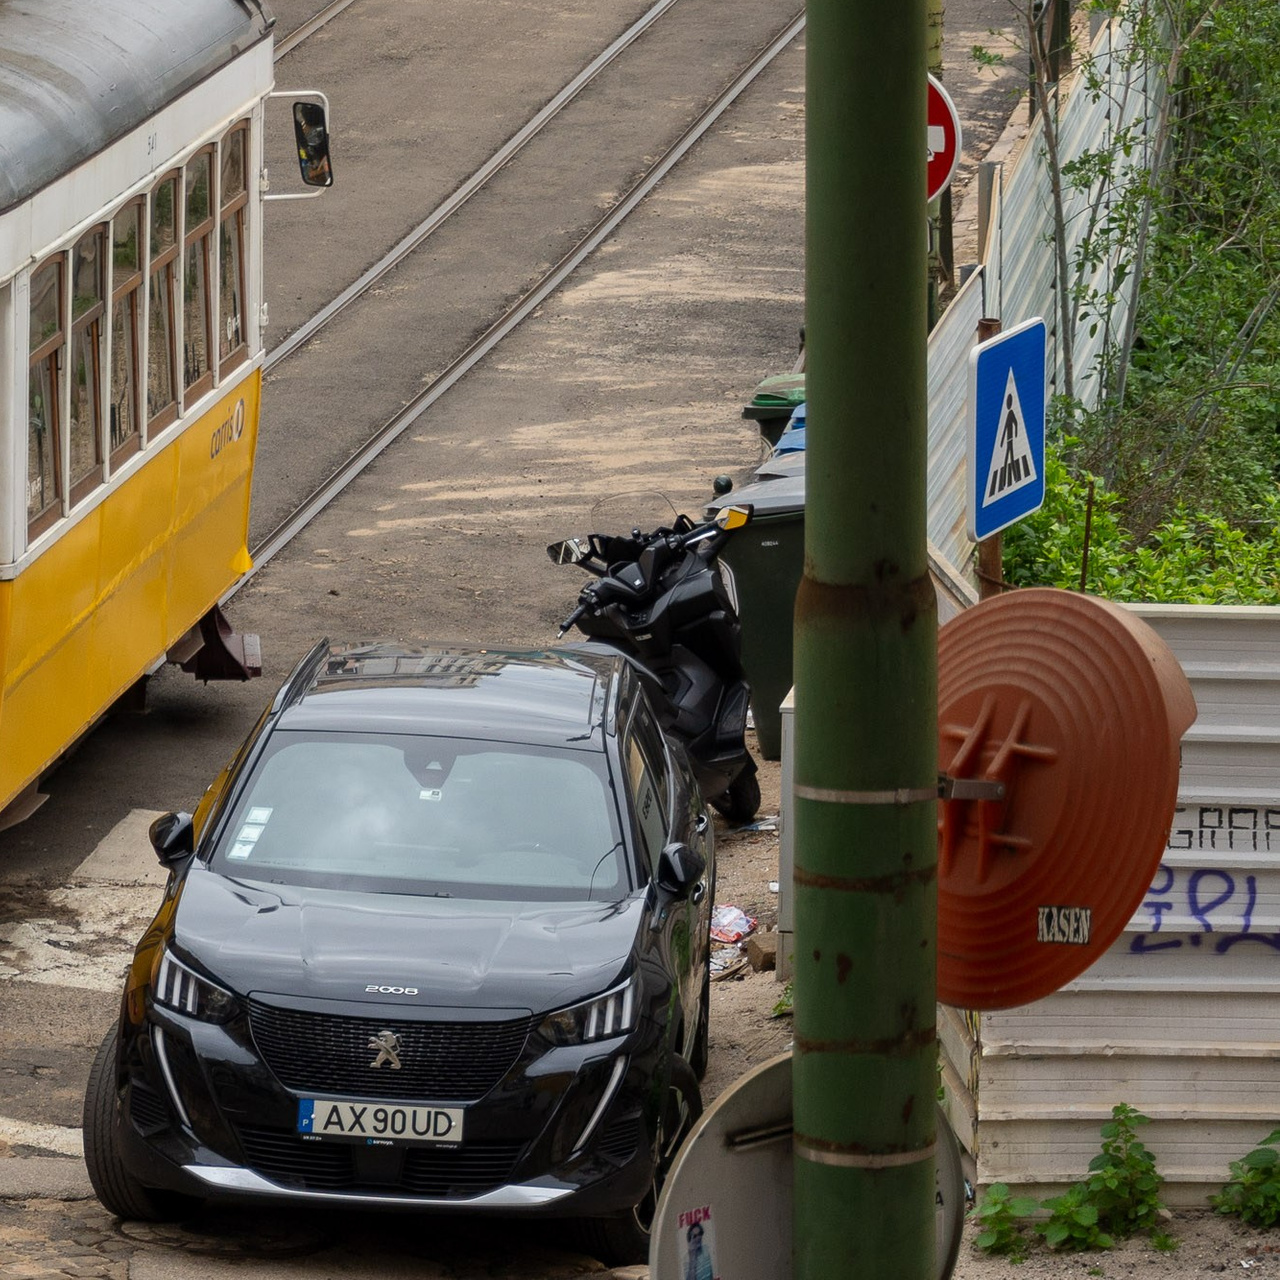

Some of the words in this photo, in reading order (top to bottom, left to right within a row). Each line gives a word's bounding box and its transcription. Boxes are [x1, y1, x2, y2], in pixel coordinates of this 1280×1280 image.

[365, 984, 419, 996] 2008
[302, 1118, 309, 1127] P
[678, 1204, 712, 1228] FUCK
